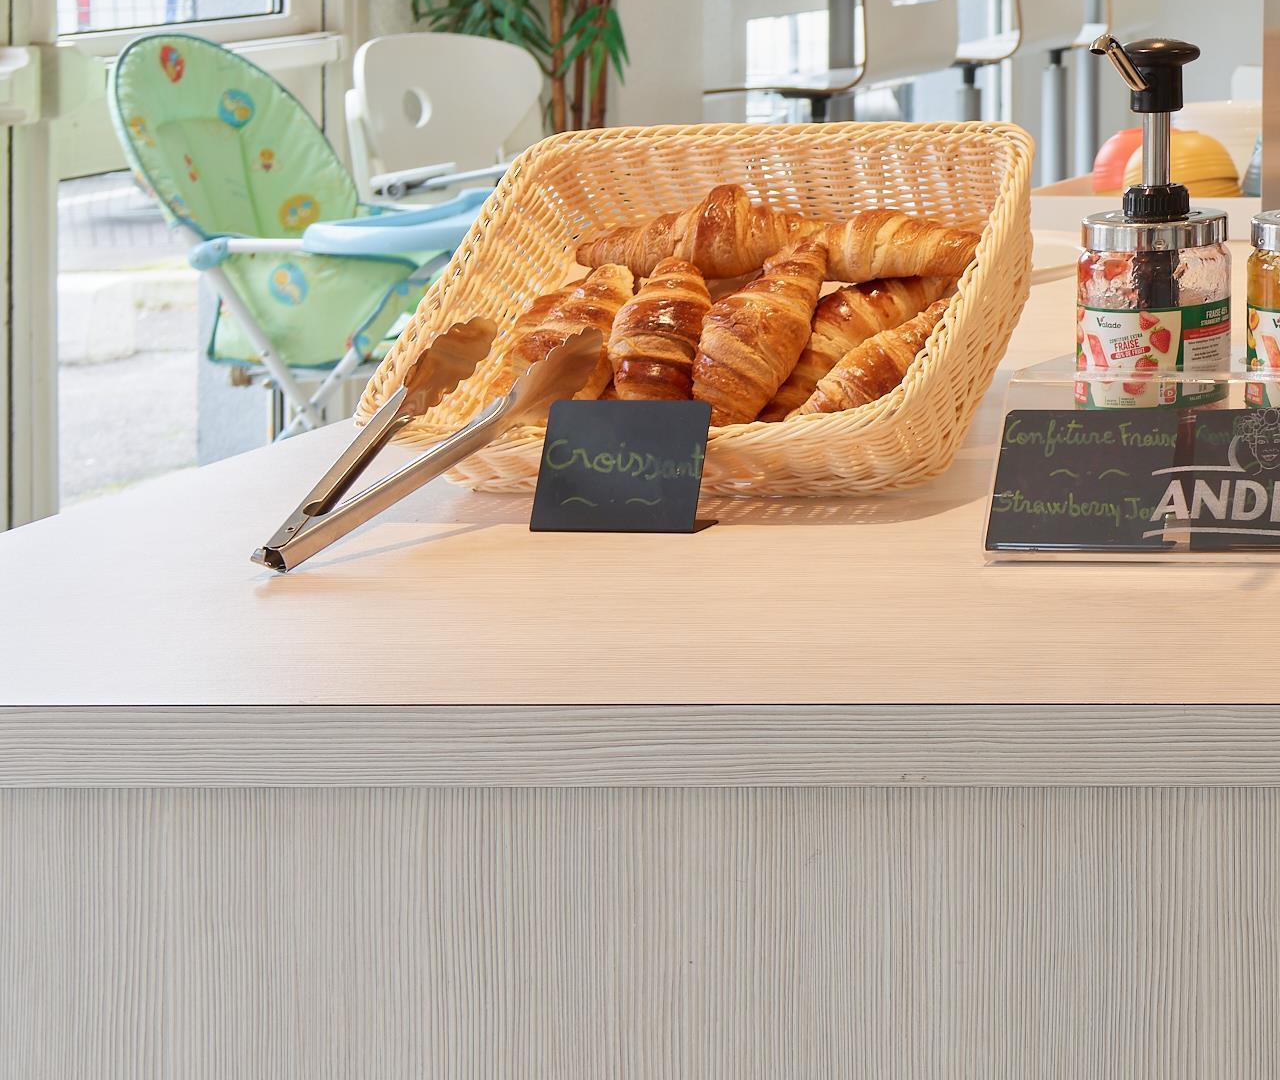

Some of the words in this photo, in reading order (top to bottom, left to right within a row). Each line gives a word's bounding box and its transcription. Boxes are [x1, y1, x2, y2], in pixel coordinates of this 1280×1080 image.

[1096, 316, 1122, 329] Valade
[1114, 338, 1140, 352] FRAISE
[1006, 419, 1115, 457] Confiture
[545, 438, 705, 481] Croissant
[991, 489, 1121, 527] Strawberry
[1124, 496, 1158, 520] Ja
